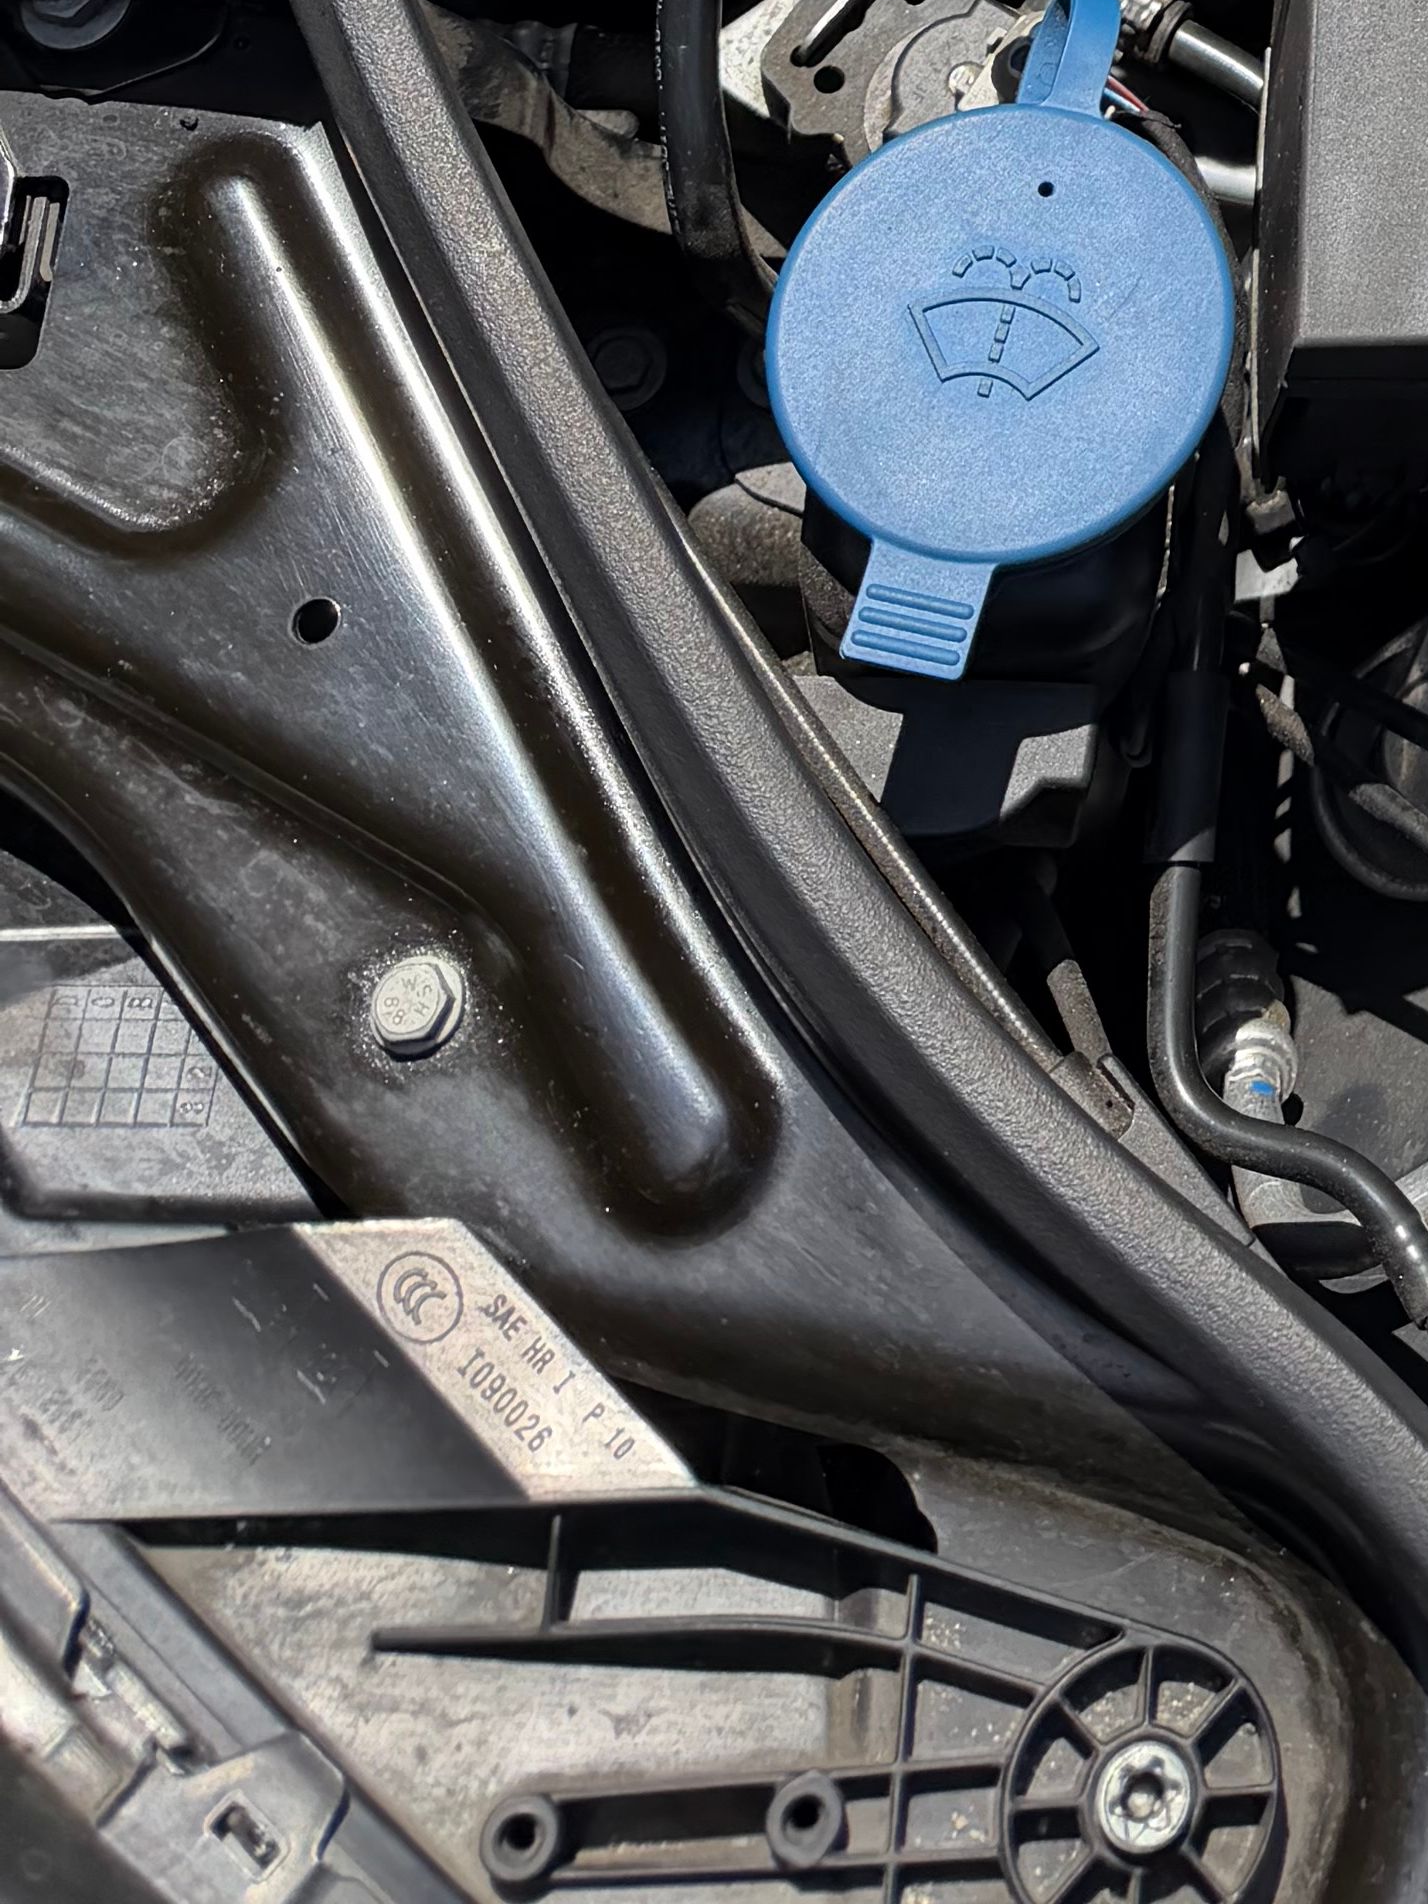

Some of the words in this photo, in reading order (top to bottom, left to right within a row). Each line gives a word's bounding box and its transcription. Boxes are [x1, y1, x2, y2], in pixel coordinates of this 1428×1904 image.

[483, 1294, 528, 1342] SAE
[521, 1336, 556, 1375] HR
[582, 1402, 605, 1423] P
[604, 1427, 636, 1460] 10
